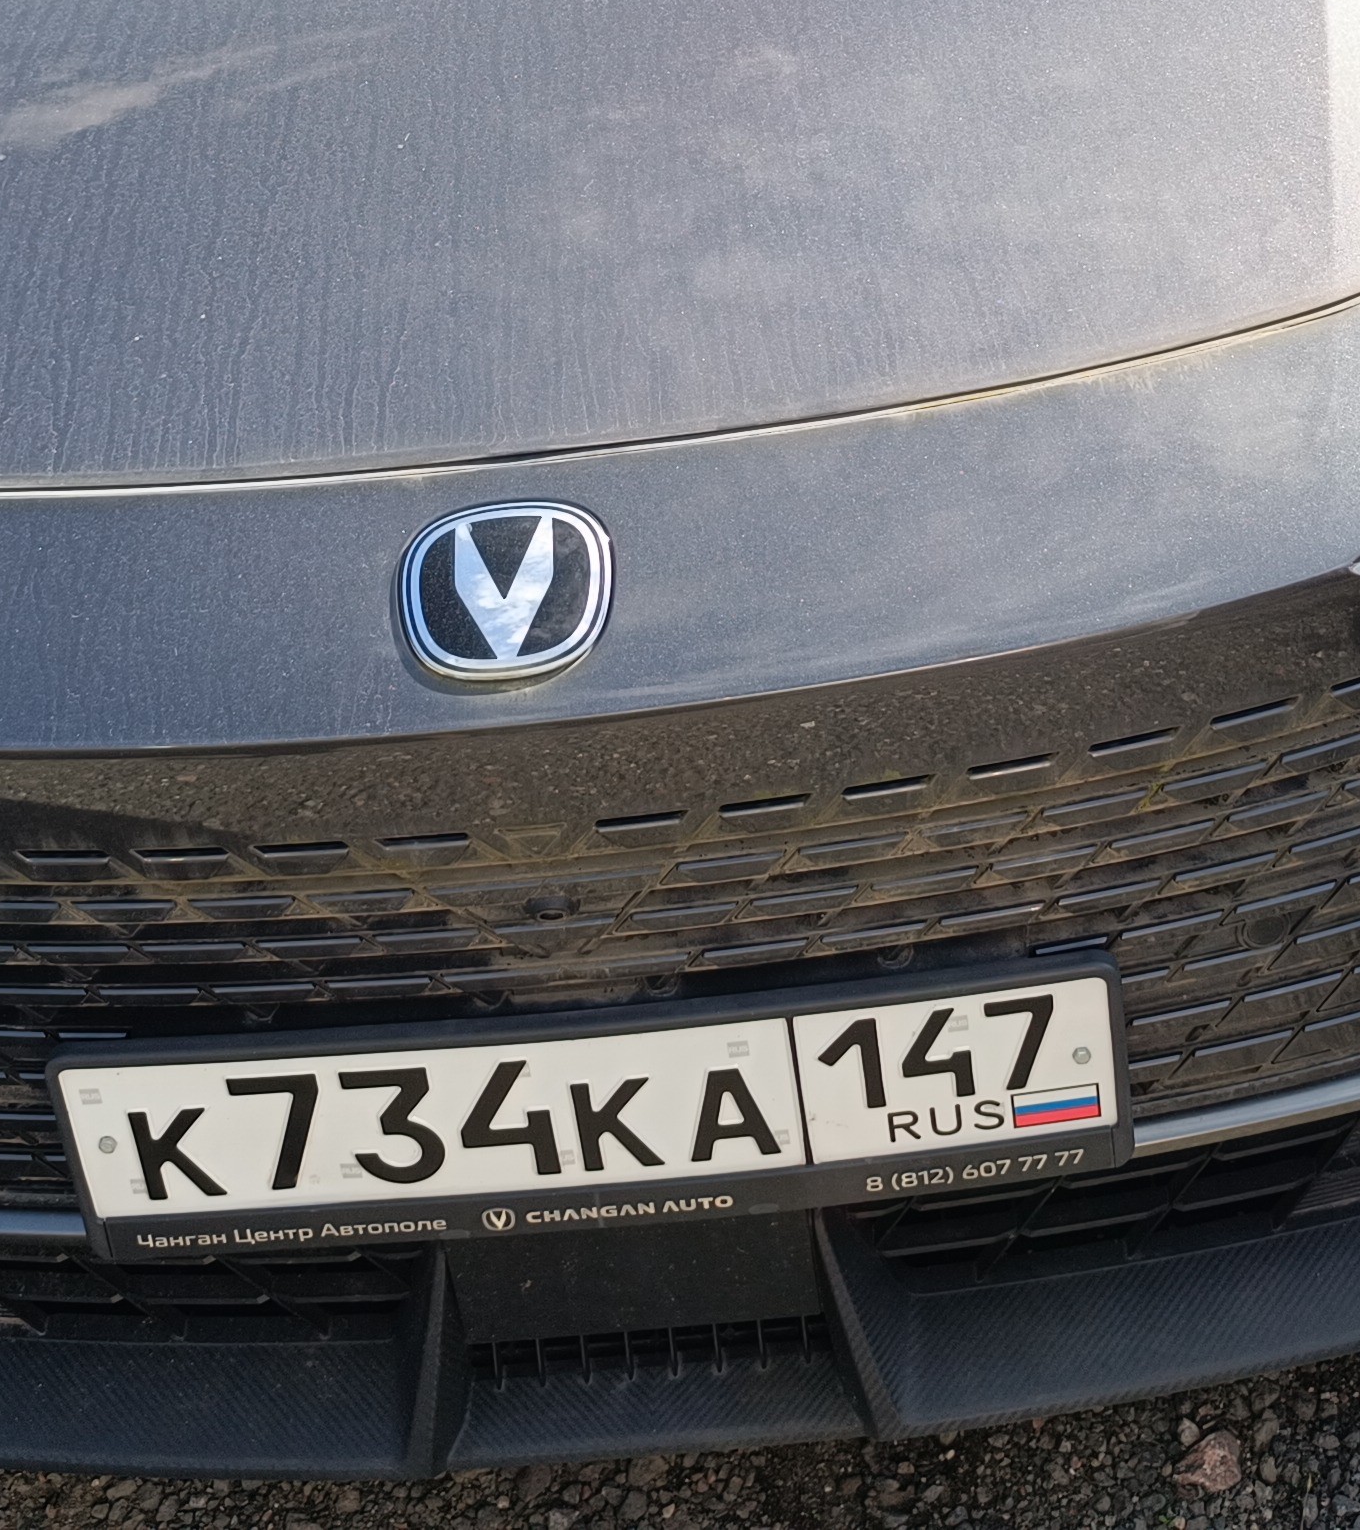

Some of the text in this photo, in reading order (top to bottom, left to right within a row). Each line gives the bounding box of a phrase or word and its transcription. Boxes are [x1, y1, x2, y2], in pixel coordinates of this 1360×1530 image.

[817, 994, 1054, 1108] 147
[888, 1100, 1005, 1143] RUS
[866, 1149, 1085, 1192] 8 (812) 607 77 77
[526, 1195, 734, 1223] CHANGAN AUTO
[137, 1219, 448, 1248] Чанган Центр Автополе
